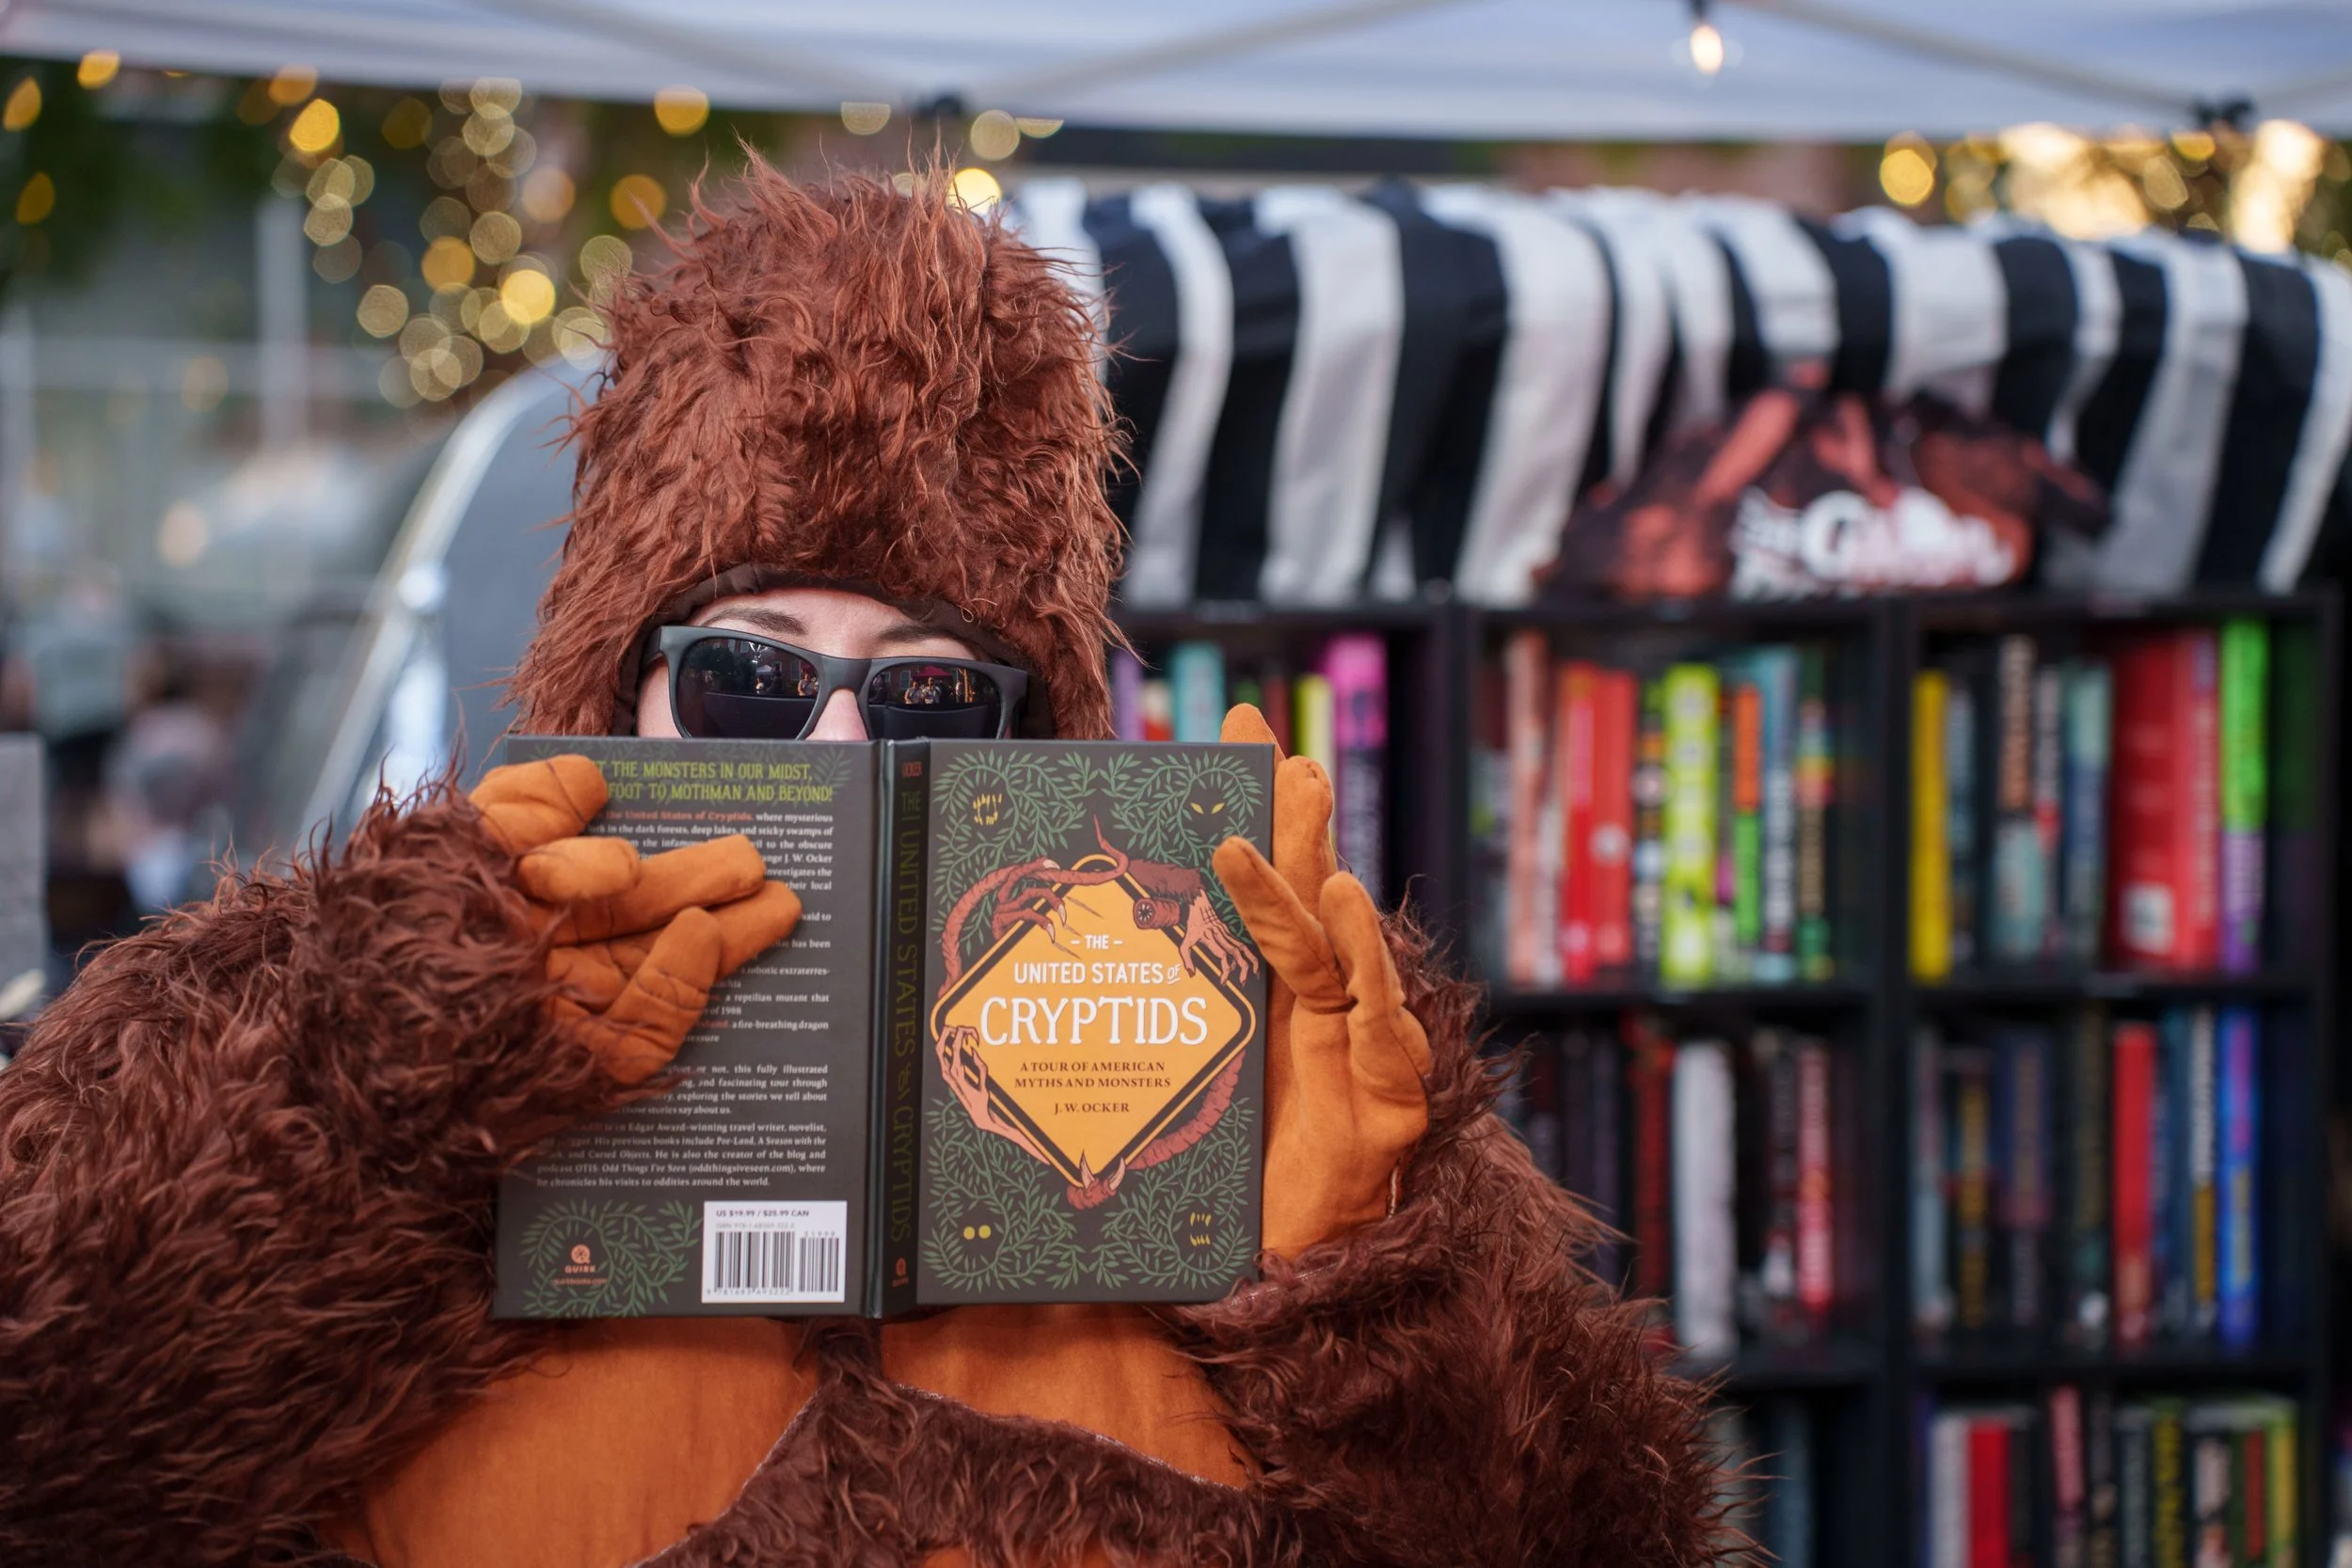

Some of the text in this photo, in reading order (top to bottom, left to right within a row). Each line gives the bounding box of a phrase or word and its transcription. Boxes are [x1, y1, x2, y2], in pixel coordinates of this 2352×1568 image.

[612, 760, 638, 778] THE
[644, 761, 715, 779] MONSTERS
[721, 762, 734, 780] IN
[739, 763, 763, 780] OUR
[769, 763, 813, 782] MIDST,
[609, 782, 833, 802] FOOT TO MOTHMAN AND BEYOND!
[626, 811, 658, 820] United
[660, 811, 691, 820] States
[694, 811, 706, 820] of
[755, 812, 783, 822] where
[785, 813, 834, 824] mysterious
[608, 825, 617, 834] in
[619, 824, 633, 834] the
[635, 824, 656, 834] dark
[658, 825, 689, 835] forests,
[691, 825, 712, 837] deep
[740, 826, 756, 835] and
[758, 826, 784, 837] sticky
[786, 828, 821, 838] swamps
[822, 827, 834, 836] of
[643, 838, 658, 847] the
[766, 841, 777, 849] to
[780, 839, 794, 849] the
[798, 840, 833, 850] obscure
[806, 854, 833, 863] Ocker
[818, 867, 833, 877] the
[811, 880, 833, 890] local
[898, 830, 921, 935] UNITED
[821, 912, 832, 922] to
[791, 939, 807, 949] has
[810, 939, 831, 949] been
[1085, 934, 1110, 950] THE
[1014, 962, 1086, 984] UNITED
[1091, 962, 1164, 984] STATES
[734, 992, 772, 1004] reptilian
[775, 994, 808, 1003] mutant
[810, 992, 830, 1003] that
[894, 943, 919, 1057] STATES
[709, 1006, 721, 1015] of
[738, 1020, 798, 1031] fire-breathing
[799, 1020, 829, 1031] dragon
[980, 995, 1209, 1046] CRYPTIDS
[734, 1064, 752, 1074] this
[756, 1064, 778, 1076] fully
[783, 1064, 828, 1074] illustrated
[1021, 1062, 1166, 1071] A TOUR OF AMERICAN
[718, 1077, 767, 1089] fascinating
[770, 1079, 789, 1087] tour
[792, 1078, 828, 1089] through
[1014, 1078, 1171, 1088] MYTHS AND MONSTERS
[676, 1091, 719, 1102] exploring
[721, 1091, 736, 1101] the
[738, 1091, 768, 1101] stories
[770, 1092, 783, 1101] we
[785, 1091, 800, 1101] tell
[802, 1091, 827, 1101] about
[647, 1105, 677, 1115] stories
[678, 1106, 693, 1117] say
[693, 1105, 718, 1115] about
[719, 1106, 732, 1115] us.
[1055, 1102, 1130, 1116] J. W. OCKER
[628, 1122, 654, 1133] Edgar
[729, 1122, 755, 1132] travel
[756, 1122, 787, 1133] writer,
[788, 1122, 827, 1133] novelist,
[595, 1135, 611, 1146] His
[612, 1136, 651, 1148] previous
[653, 1135, 680, 1146] books
[681, 1135, 715, 1146] include
[757, 1136, 765, 1146] A
[766, 1135, 793, 1146] Season
[794, 1135, 812, 1146] with
[813, 1135, 827, 1146] the
[587, 1149, 617, 1159] Cursed
[655, 1149, 669, 1159] He
[671, 1149, 680, 1159] is
[682, 1148, 702, 1160] also
[704, 1148, 719, 1159] the
[722, 1149, 754, 1159] creator
[755, 1148, 767, 1159] of
[769, 1148, 784, 1159] the
[786, 1148, 806, 1162] blog
[808, 1148, 827, 1159] and
[601, 1164, 620, 1173] Odd
[621, 1164, 648, 1175] Things
[667, 1164, 687, 1173] Seen
[798, 1164, 826, 1173] where
[890, 1105, 914, 1242] CRYPTIDS
[549, 1177, 596, 1186] chronicles
[598, 1177, 612, 1186] his
[614, 1177, 640, 1186] visits
[642, 1177, 652, 1186] to
[653, 1177, 690, 1187] oddities
[691, 1177, 724, 1187] around
[725, 1177, 741, 1187] the
[742, 1177, 771, 1187] world.
